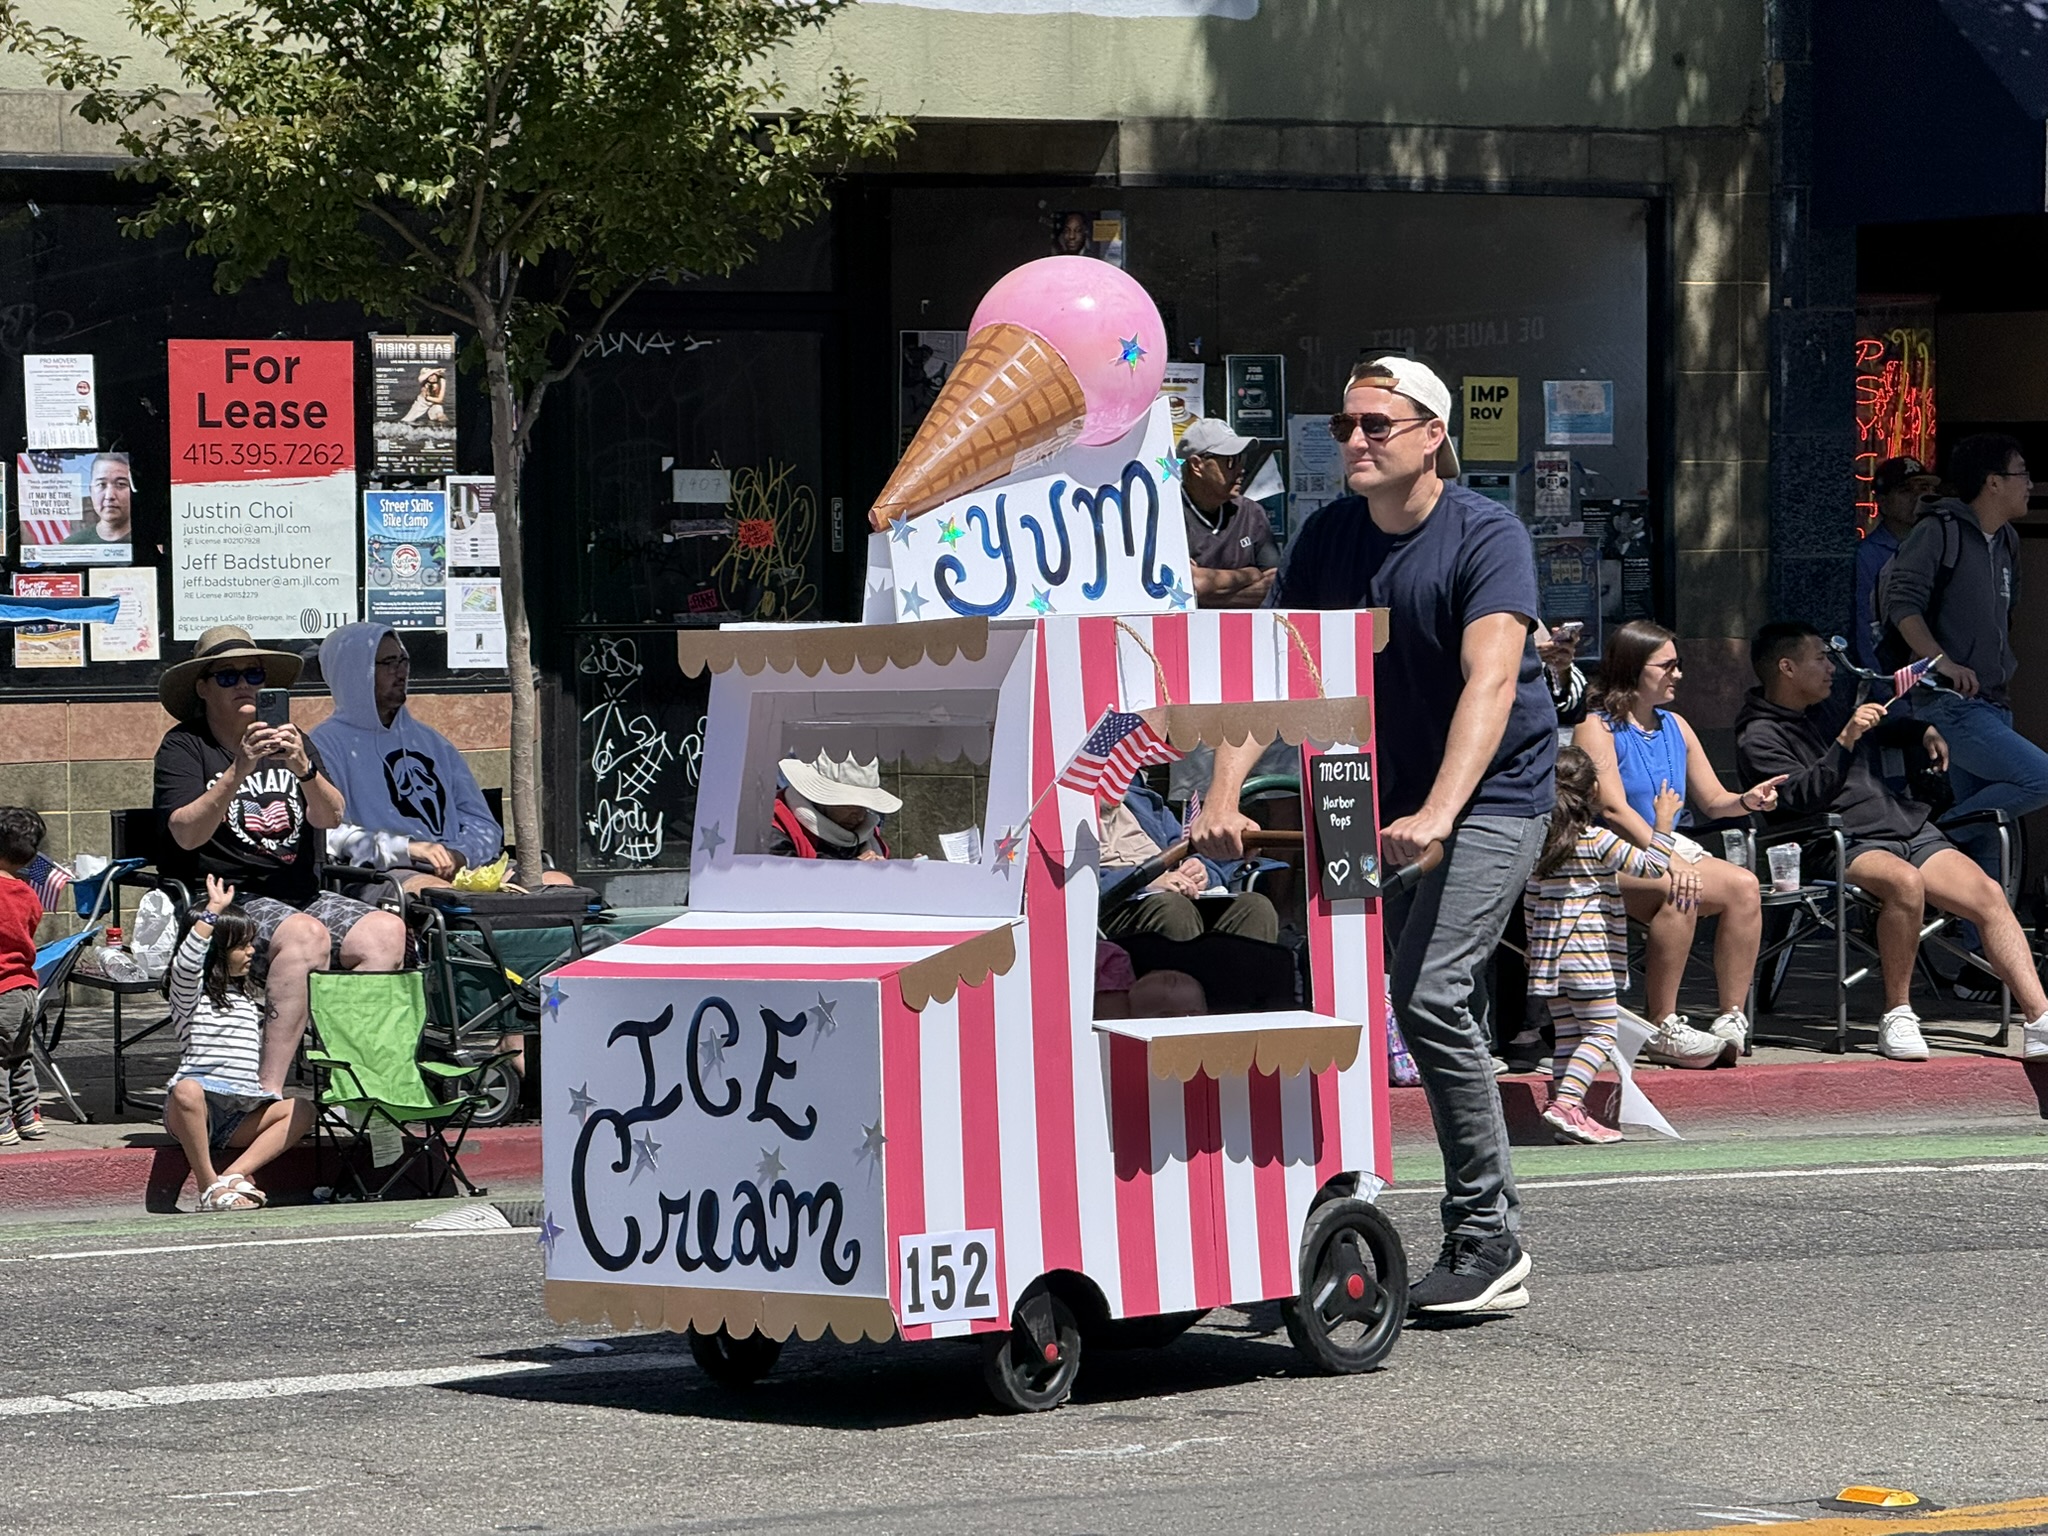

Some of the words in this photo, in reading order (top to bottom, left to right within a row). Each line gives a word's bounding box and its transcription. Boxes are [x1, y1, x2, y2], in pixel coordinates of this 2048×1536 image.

[375, 342, 416, 352] RISING
[419, 342, 452, 352] SEAS
[225, 348, 300, 384] For
[1471, 385, 1509, 403] IMP
[197, 392, 328, 429] Lease
[1470, 407, 1503, 420] ROV
[182, 443, 344, 466] 415.395.7262
[28, 491, 35, 499] IT
[35, 491, 47, 499] MAY
[49, 491, 57, 499] BE
[58, 491, 72, 499] TIME
[53, 500, 69, 508] YOUR
[181, 501, 241, 519] Justin
[248, 501, 294, 519] Choi
[380, 499, 409, 512] Street
[411, 498, 434, 513] Skills
[382, 513, 403, 526] Bike
[403, 513, 429, 529] Camp
[833, 502, 841, 539] PULL
[183, 524, 311, 535] justin.choi@am.jll.com
[181, 553, 217, 570] Jeff
[223, 553, 331, 570] Badstubner
[182, 576, 339, 589] jeff.badstubner@am.jll.com
[201, 615, 218, 623] Lang
[1322, 795, 1355, 810] Harbor
[1329, 813, 1352, 830] Pops
[606, 996, 818, 1141] ICE
[571, 1108, 861, 1286] Cream
[906, 1241, 990, 1313] 152
